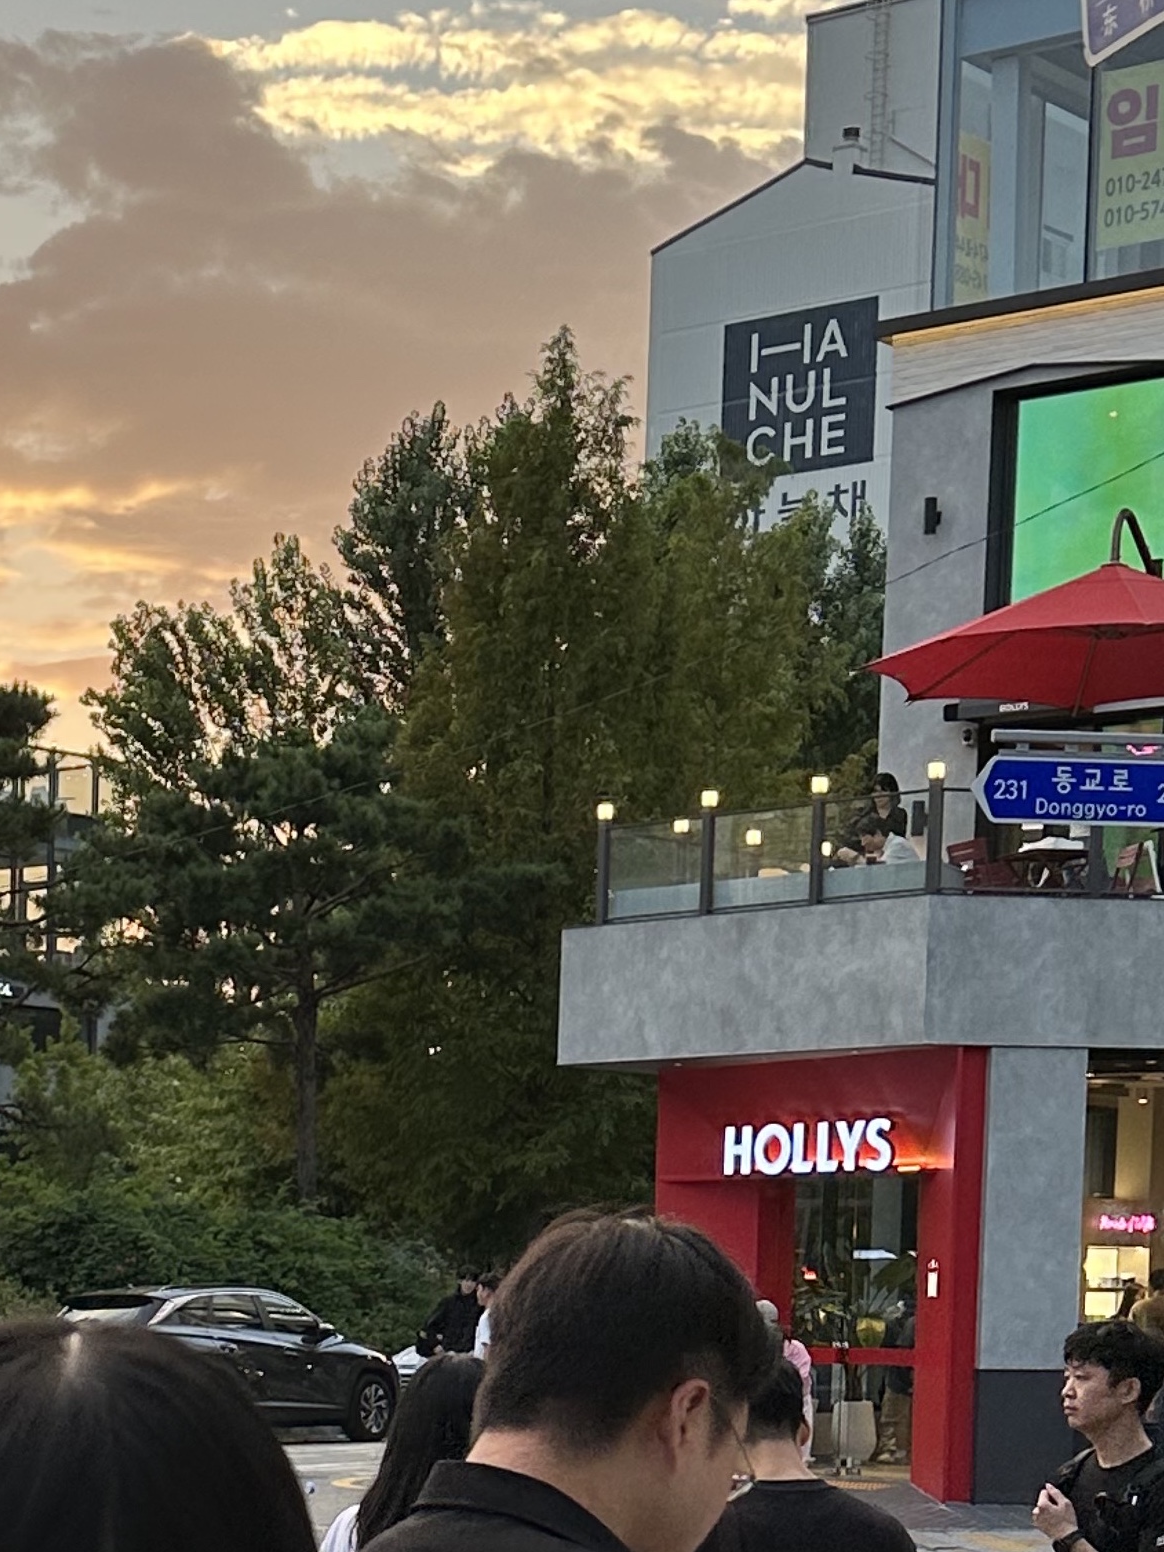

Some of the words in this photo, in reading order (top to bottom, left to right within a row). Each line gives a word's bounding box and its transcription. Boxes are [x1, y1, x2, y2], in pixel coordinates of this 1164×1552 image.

[1107, 84, 1159, 159] 임
[1105, 166, 1164, 197] 010-24
[749, 367, 847, 421] NUL
[747, 413, 846, 466] CHE
[993, 779, 1028, 800] 231
[1051, 766, 1133, 794] 동교로
[1035, 797, 1147, 820] Donggyo-ro
[723, 1117, 892, 1176] HOLLYS
